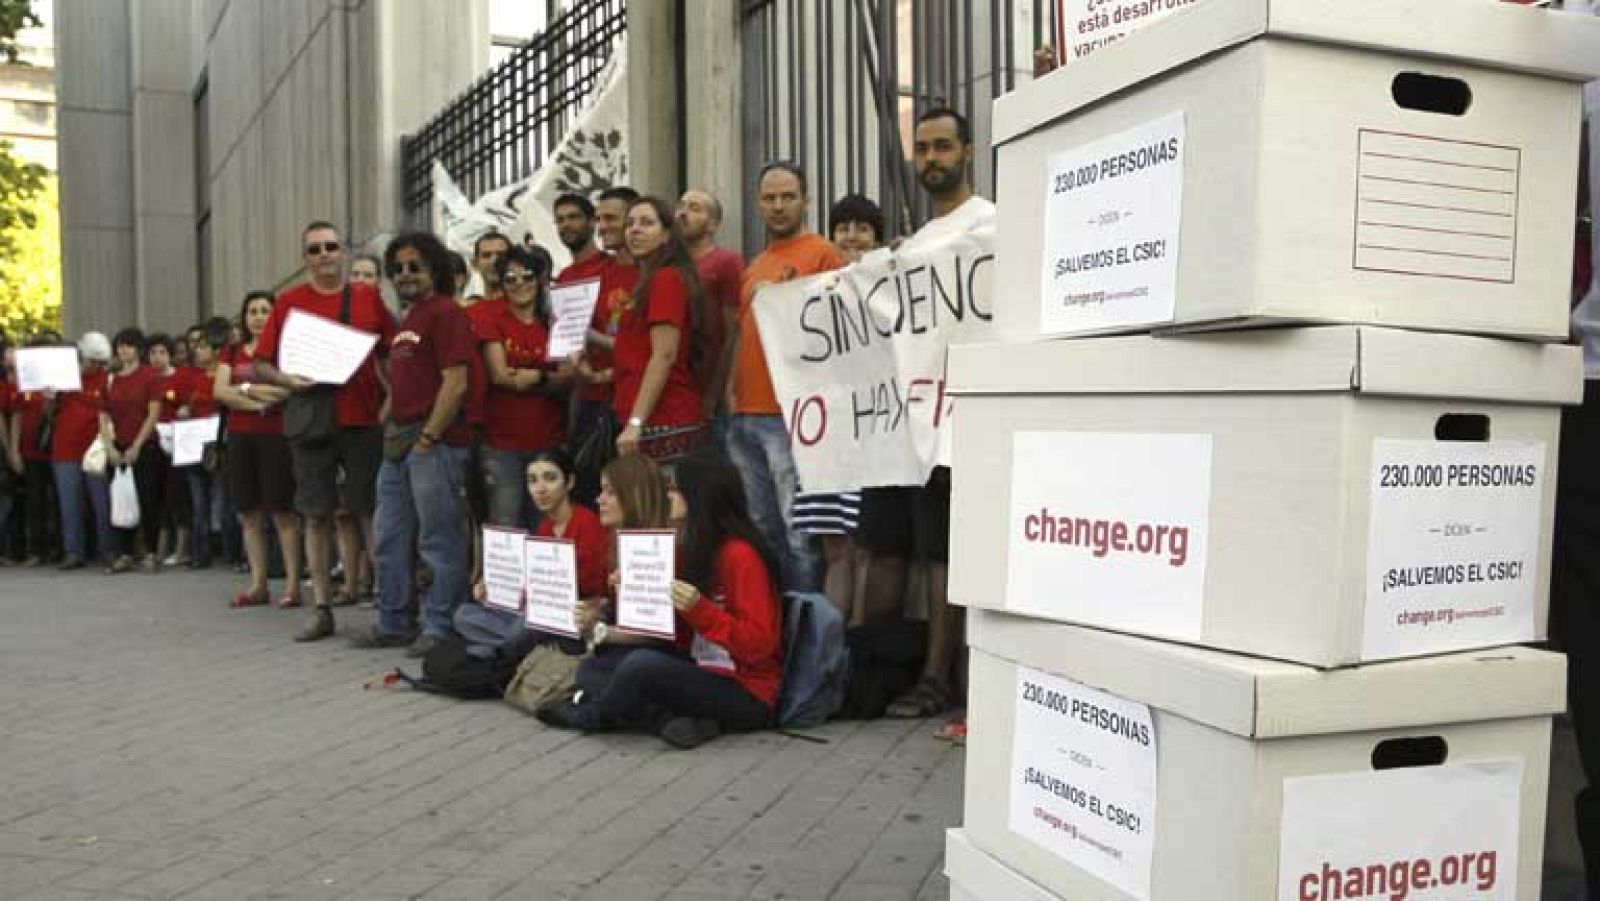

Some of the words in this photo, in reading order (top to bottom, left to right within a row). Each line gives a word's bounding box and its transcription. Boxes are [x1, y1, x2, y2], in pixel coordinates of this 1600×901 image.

[1100, 137, 1178, 180] PERSONAS
[1116, 247, 1132, 265] EL
[1133, 239, 1166, 262] CSIC!
[1380, 464, 1443, 487] 230.000
[1447, 464, 1536, 487] PERSONAS
[1024, 507, 1189, 568] change.org
[1468, 562, 1485, 582] EL
[1487, 560, 1524, 581] CSIC!
[1071, 698, 1150, 747] PERSONAS
[1089, 796, 1103, 817] EL
[1106, 804, 1141, 835] CSIC!
[1299, 850, 1497, 901] change.org
